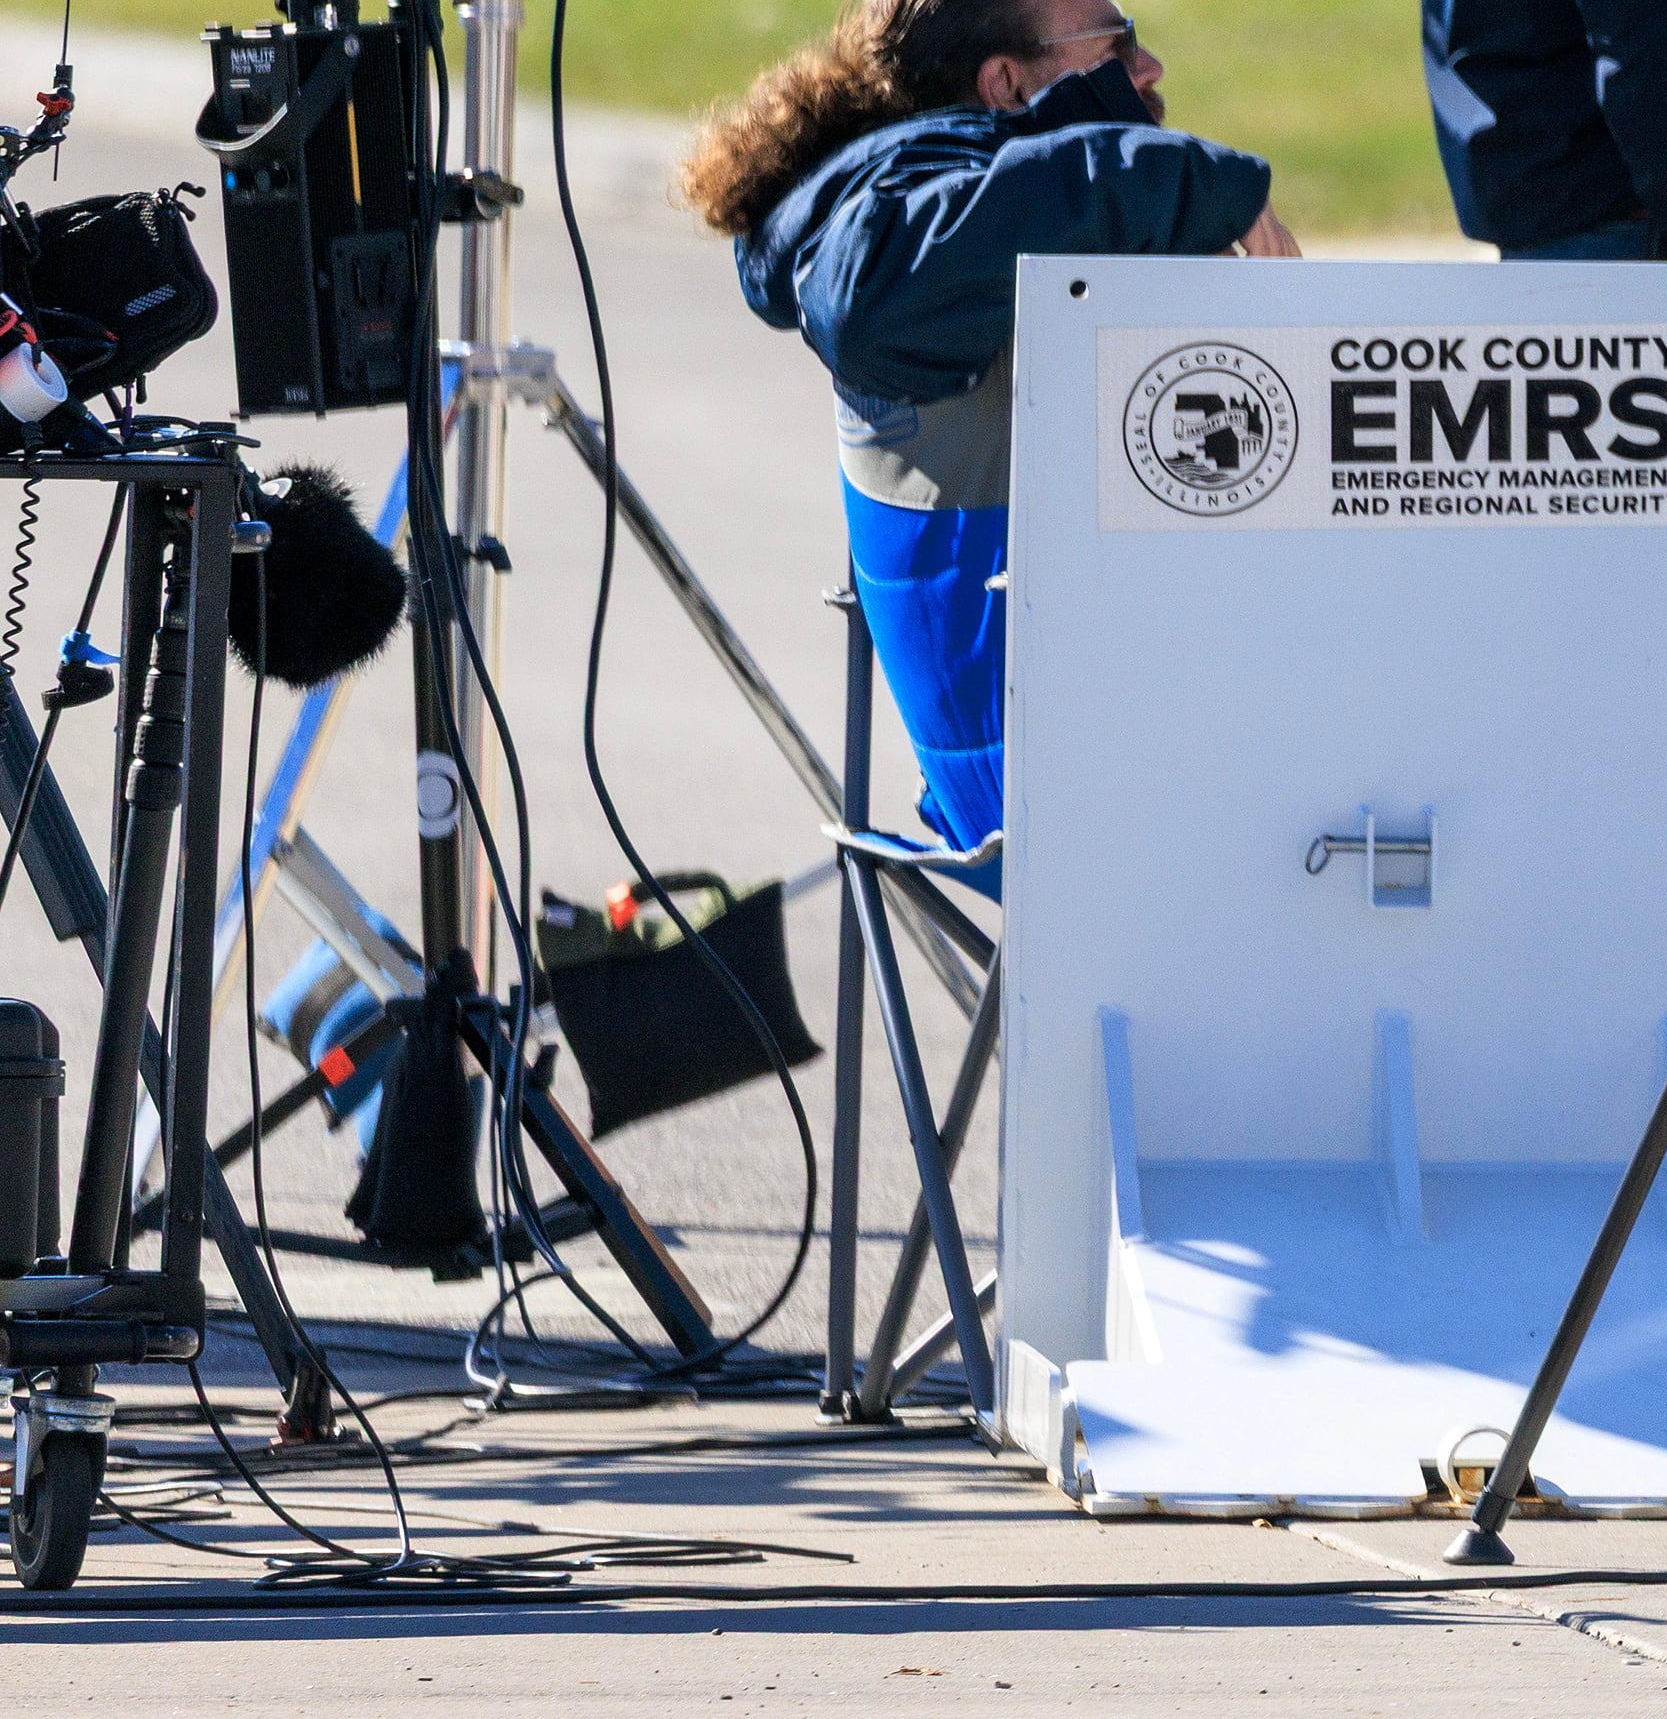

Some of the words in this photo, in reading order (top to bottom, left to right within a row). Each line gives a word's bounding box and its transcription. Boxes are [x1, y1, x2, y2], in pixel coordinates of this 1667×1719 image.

[230, 46, 276, 63] NANLITE
[1330, 337, 1468, 373] COOK
[1134, 412, 1153, 465] SEAL
[1144, 371, 1166, 397] OF
[1178, 352, 1244, 371] COOK
[1254, 370, 1290, 463] COUNTY
[1154, 474, 1266, 507] ILLINOIS
[1331, 468, 1491, 490] EMERGENCY
[1331, 495, 1390, 517] AND
[1400, 495, 1538, 517] REGIONAL
